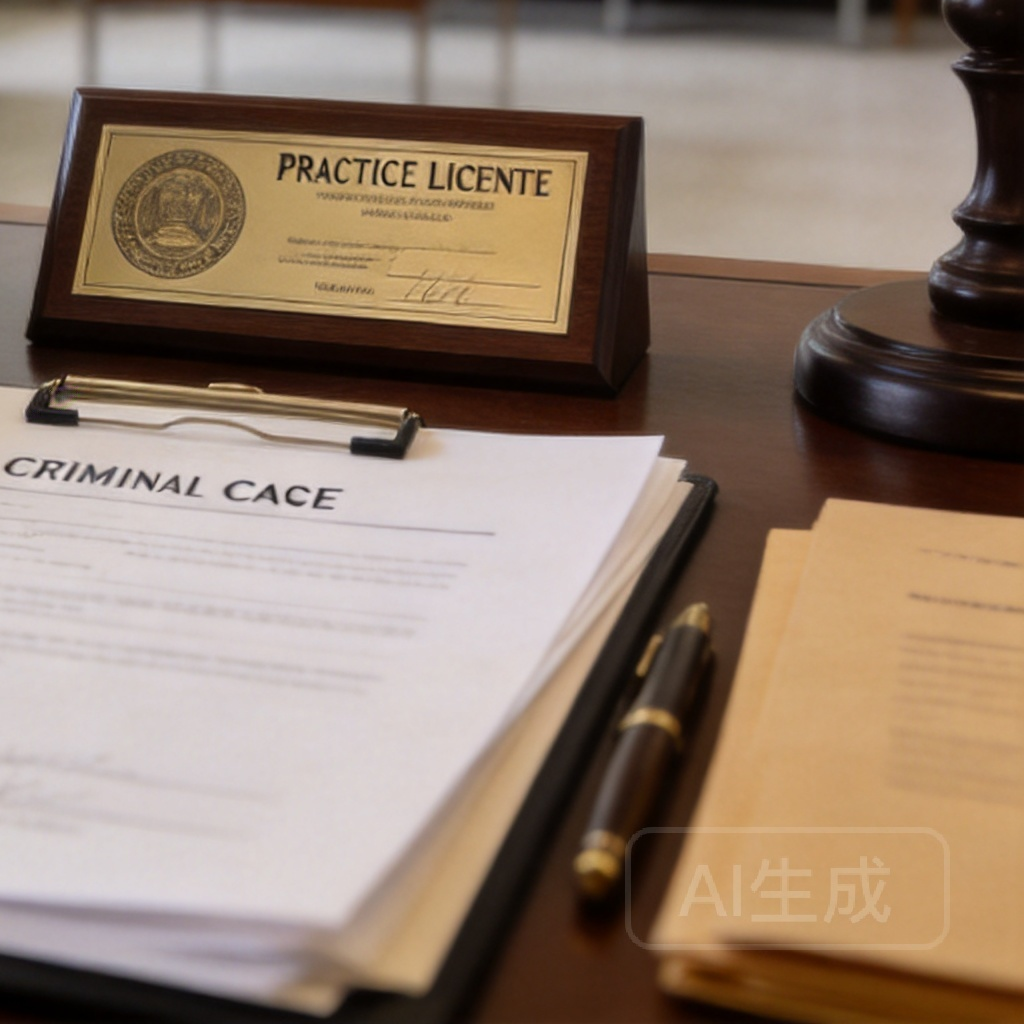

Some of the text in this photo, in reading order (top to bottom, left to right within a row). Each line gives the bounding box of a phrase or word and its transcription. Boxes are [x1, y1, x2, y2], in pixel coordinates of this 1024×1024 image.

[277, 152, 553, 197] PRACTICE LICENTE
[3, 456, 204, 498] CRIMINAL
[222, 479, 344, 511] CACE
